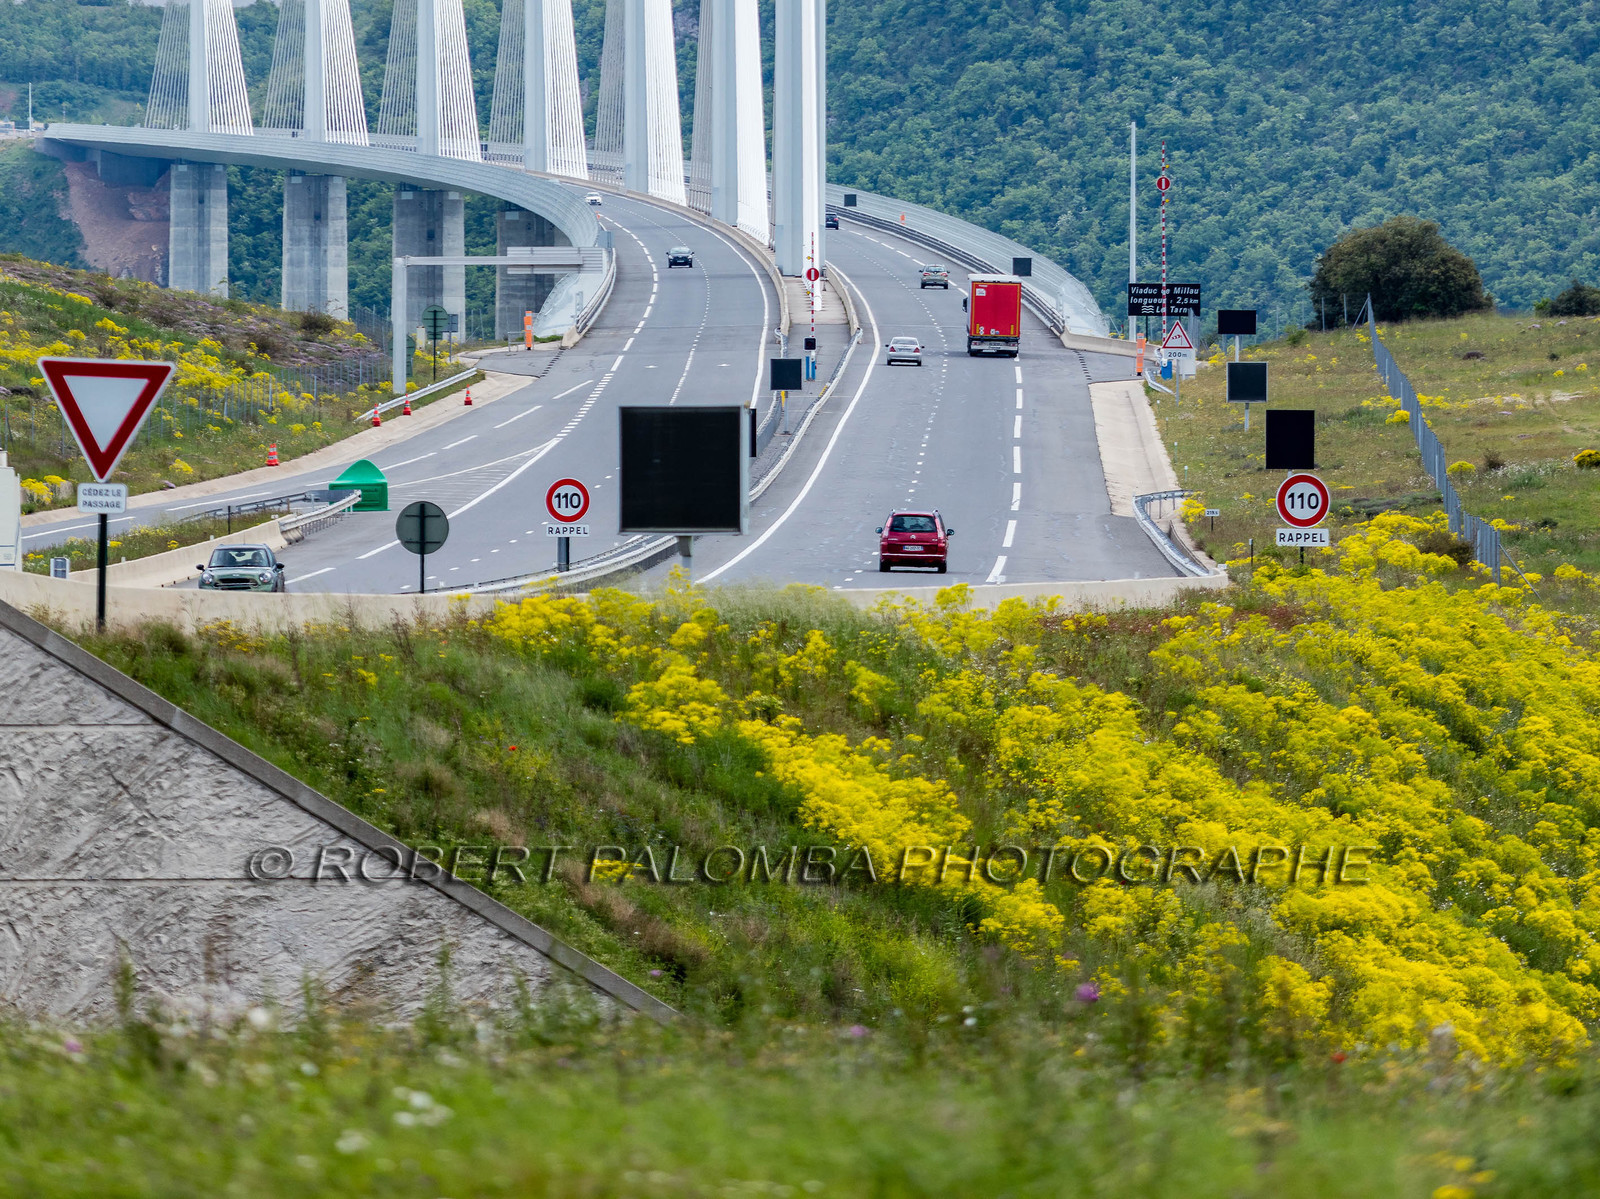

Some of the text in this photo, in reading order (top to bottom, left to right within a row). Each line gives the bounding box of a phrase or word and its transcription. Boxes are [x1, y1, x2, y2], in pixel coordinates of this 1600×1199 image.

[1131, 286, 1158, 294] Viaduc
[1173, 286, 1199, 295] Millau
[1130, 296, 1166, 305] longueu
[1176, 296, 1188, 304] 2,5
[1170, 305, 1188, 313] Tarn
[82, 488, 122, 497] CÉDEZ LE
[82, 500, 121, 509] PASSAGE
[554, 492, 581, 509] 110
[1287, 492, 1320, 510] 110
[547, 526, 589, 535] RAPPEL
[1279, 532, 1326, 543] RAPPEL
